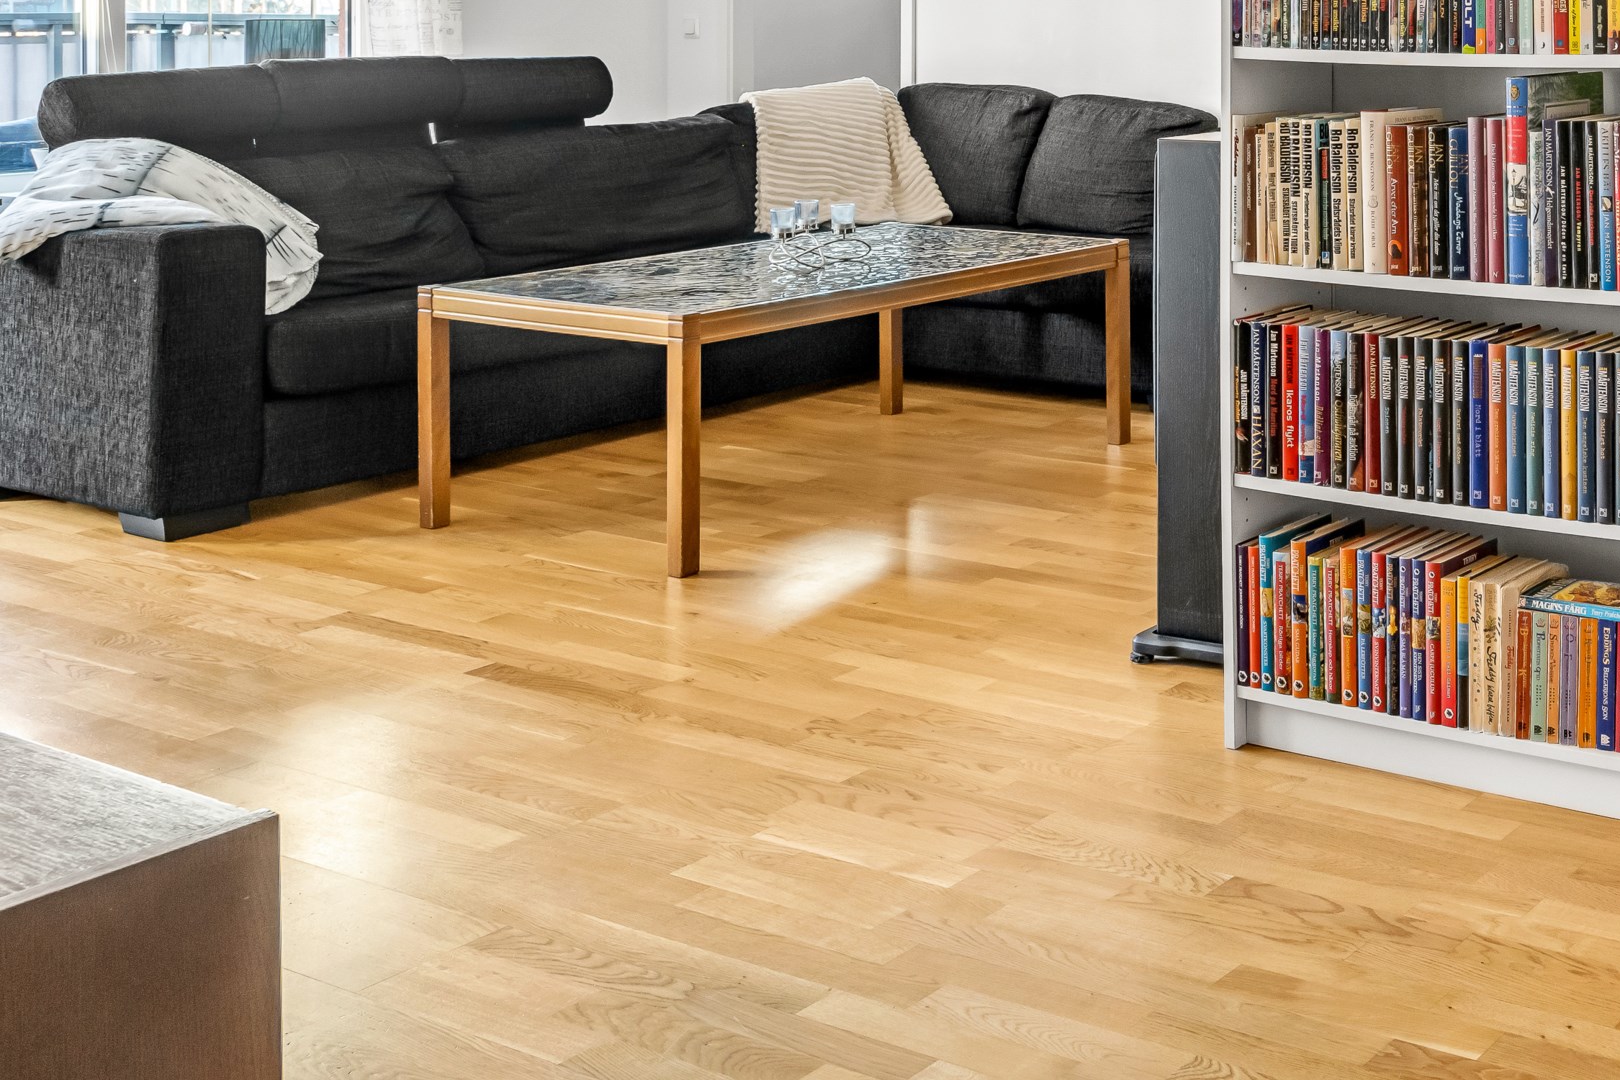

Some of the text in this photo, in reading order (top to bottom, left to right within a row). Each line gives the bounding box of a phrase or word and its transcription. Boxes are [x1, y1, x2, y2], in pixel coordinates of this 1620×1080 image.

[1331, 129, 1343, 141] Bo
[1435, 144, 1444, 162] JAN
[1280, 135, 1291, 183] BALDERSON
[1332, 143, 1343, 193] Balderson
[1347, 128, 1359, 193] Bo Balderson
[1545, 142, 1553, 187] MÅRTENSON
[1333, 238, 1342, 254] klipp
[1391, 218, 1399, 234] Arn
[1270, 330, 1278, 377] Jan Mårtenson
[1382, 359, 1392, 400] MÅRTENSON
[1400, 358, 1410, 399] MÅRTENSON
[1416, 359, 1427, 400] MÅRTENSON
[1435, 361, 1446, 403] MÅRTENSON
[1491, 361, 1503, 403] MÅRTENSON
[1509, 363, 1520, 405] MÅRTENSON
[1528, 365, 1539, 406] MÅRTENSON
[1544, 366, 1555, 408] MÅRTENSON
[1580, 370, 1591, 411] MÅRTENSON
[1598, 371, 1610, 413] MÅRTENSON
[1286, 389, 1295, 448] Ikaros flykt
[1252, 416, 1262, 470] HÄXAN
[1471, 592, 1482, 631] Freddy
[1531, 599, 1587, 615] MAGINS FÄRG
[1485, 647, 1497, 682] Freddy
[1505, 645, 1514, 669] Freddy
[1603, 627, 1611, 664] EDDINGS
